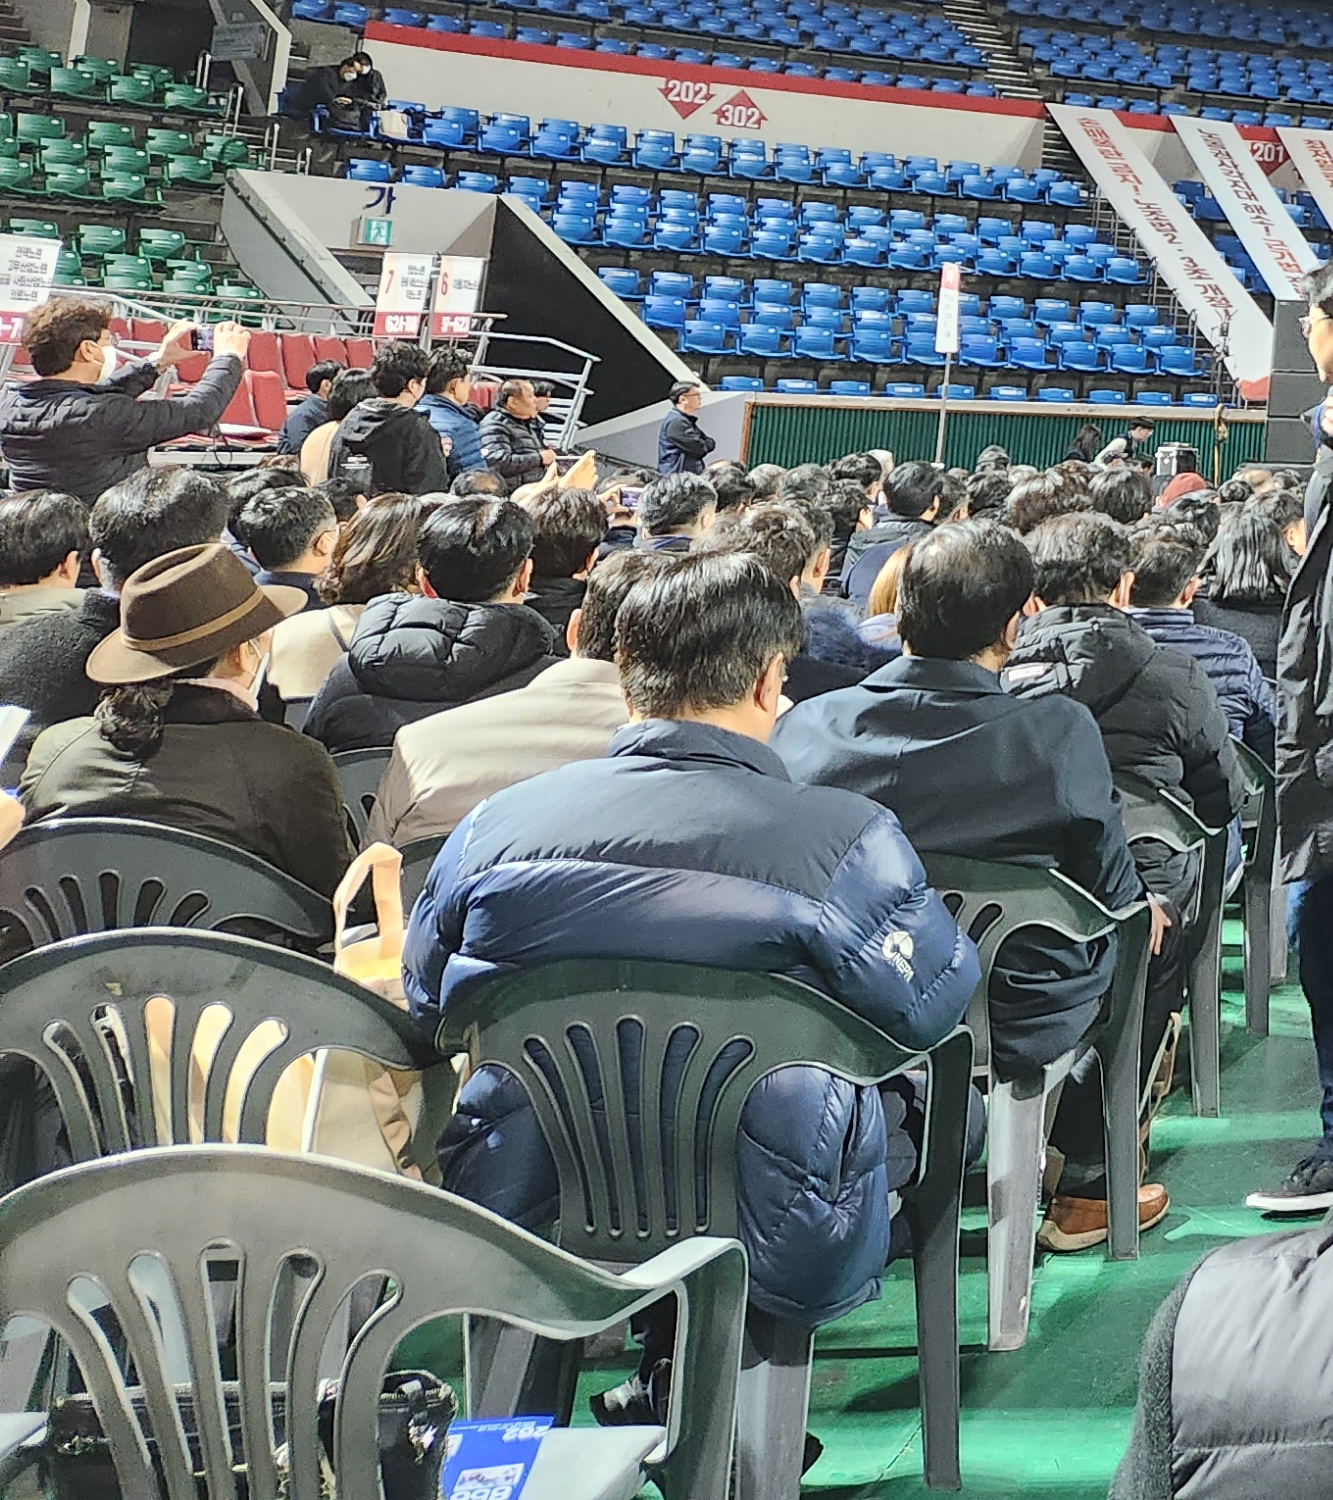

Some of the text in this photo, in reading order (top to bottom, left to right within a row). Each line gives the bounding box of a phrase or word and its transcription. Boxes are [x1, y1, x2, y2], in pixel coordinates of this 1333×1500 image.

[667, 80, 708, 104] 202
[720, 104, 760, 128] 302
[1253, 142, 1285, 163] 201
[362, 185, 397, 215] 가
